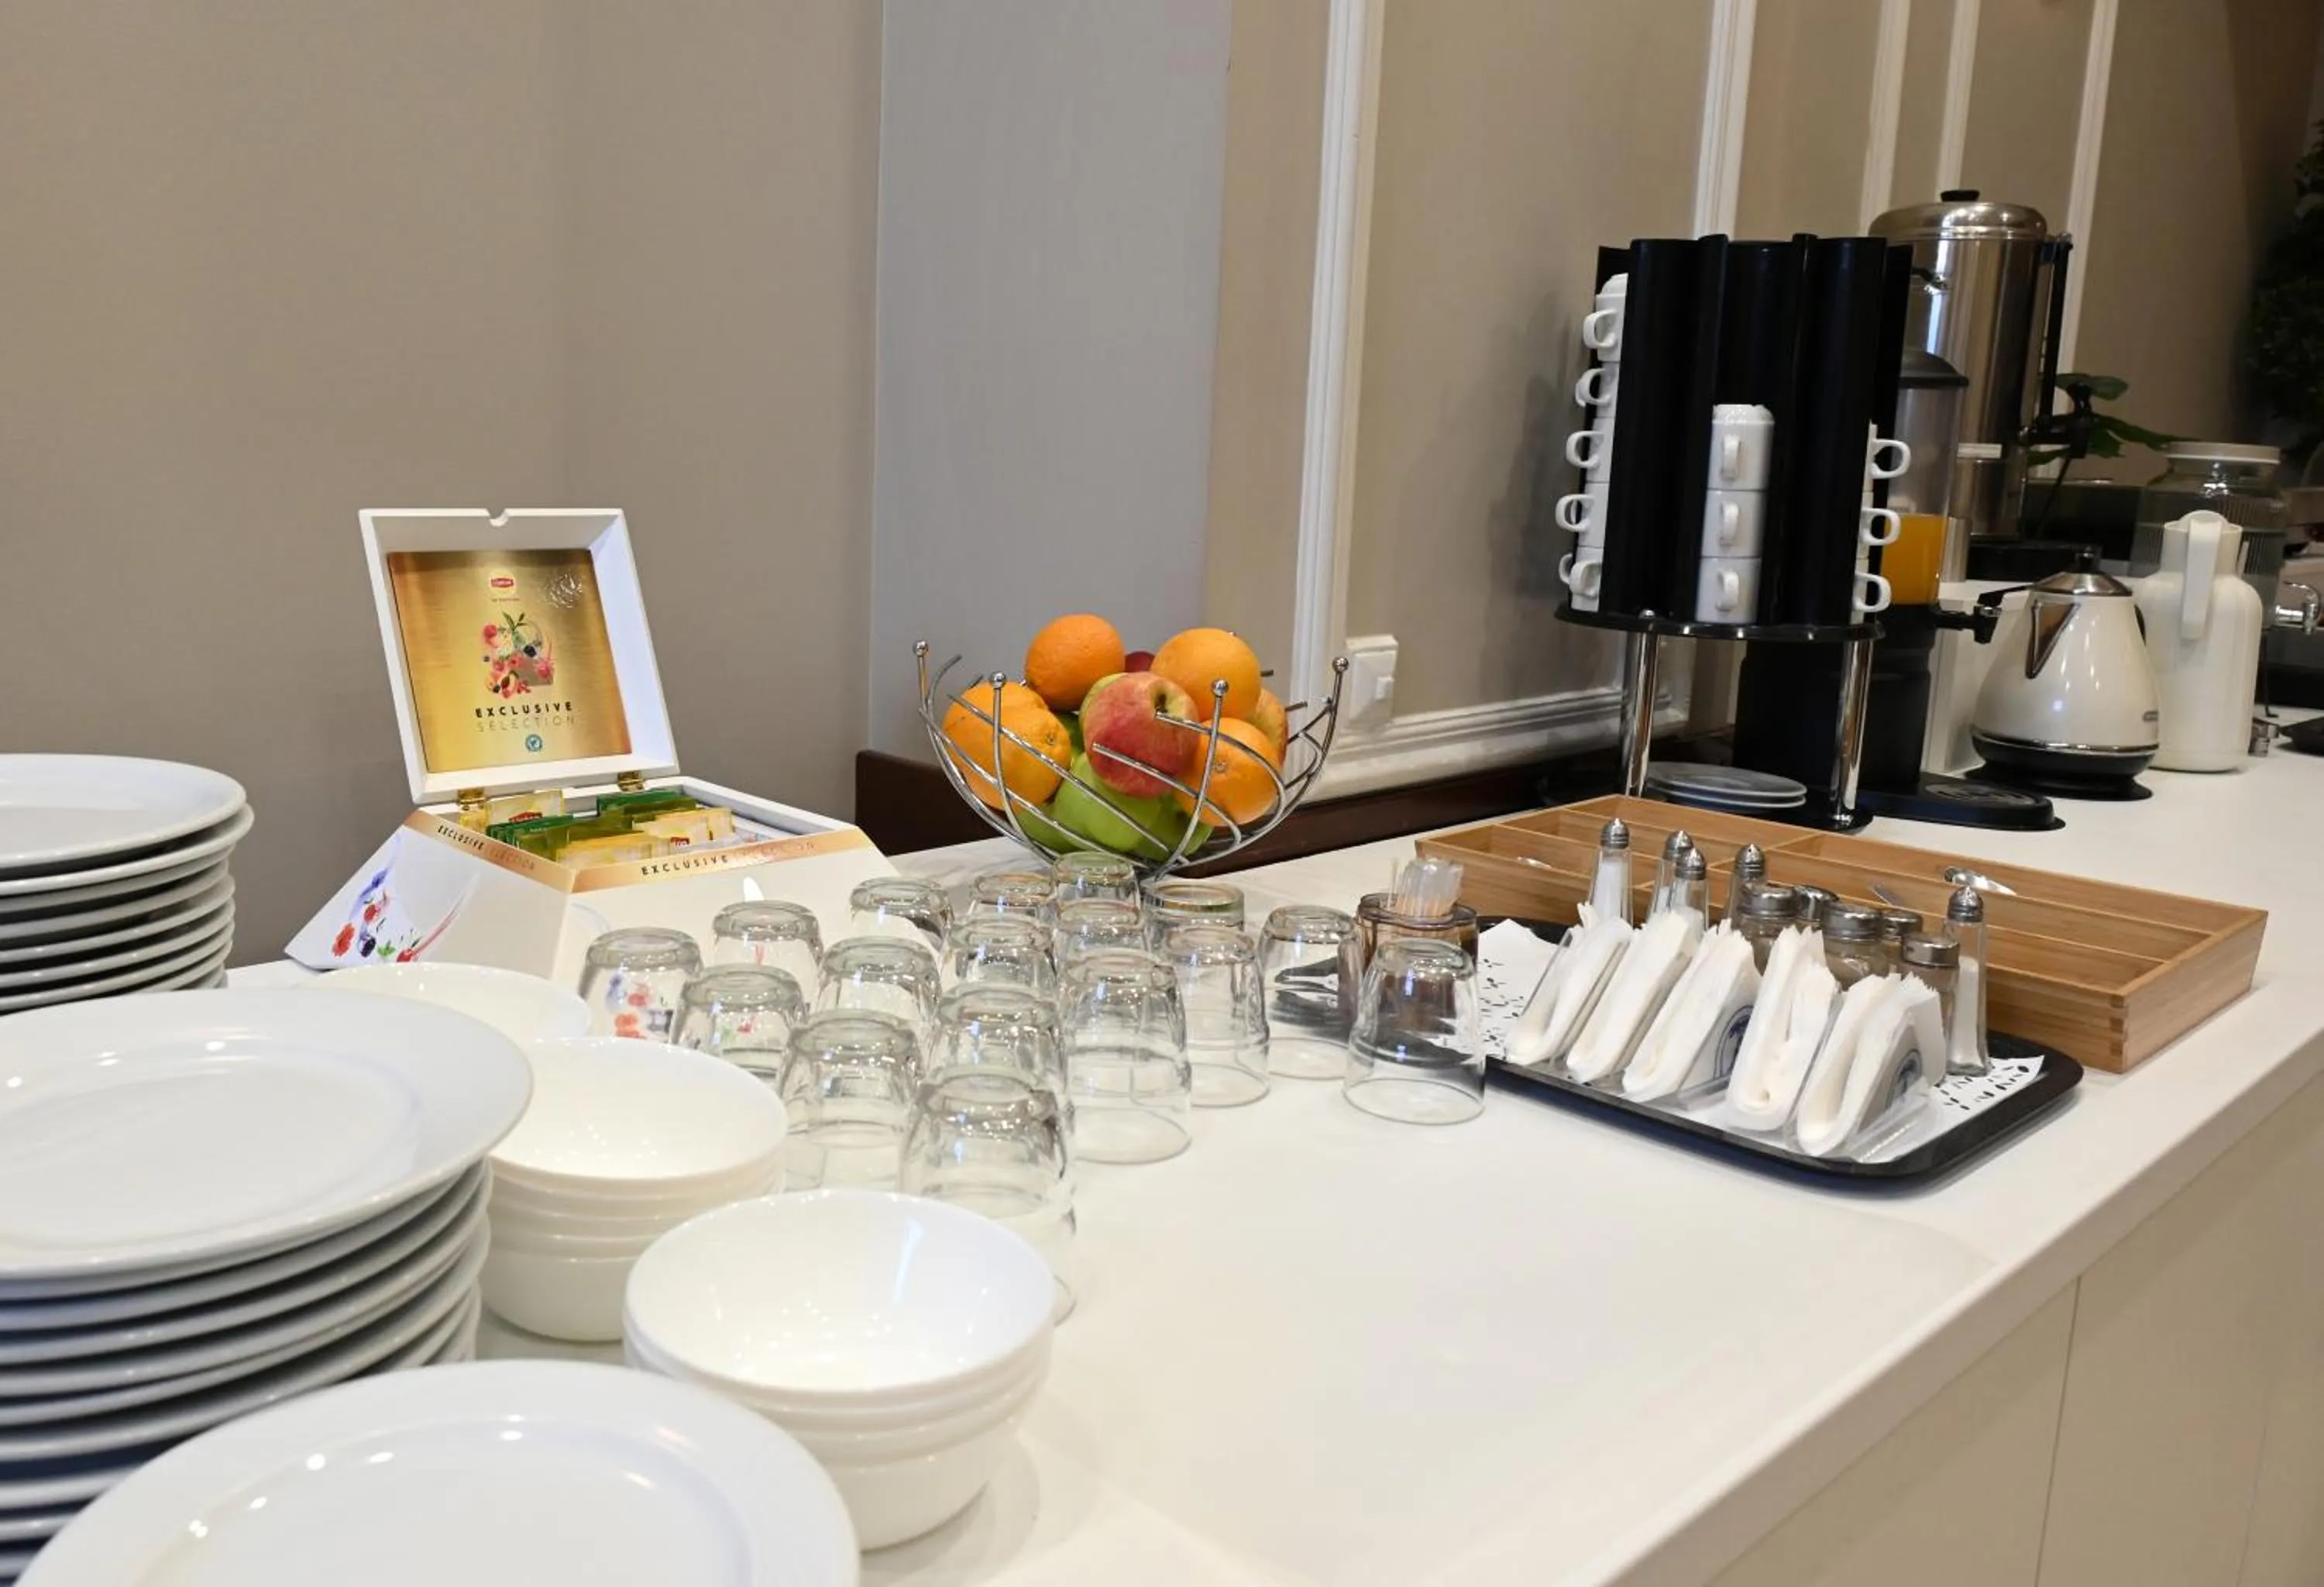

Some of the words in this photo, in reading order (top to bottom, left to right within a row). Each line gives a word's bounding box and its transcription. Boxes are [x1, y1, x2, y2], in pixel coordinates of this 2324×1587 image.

[475, 701, 572, 718] EXCLUSIVE
[477, 715, 575, 732] SELECTION
[641, 855, 728, 876] EXCLUSIVE
